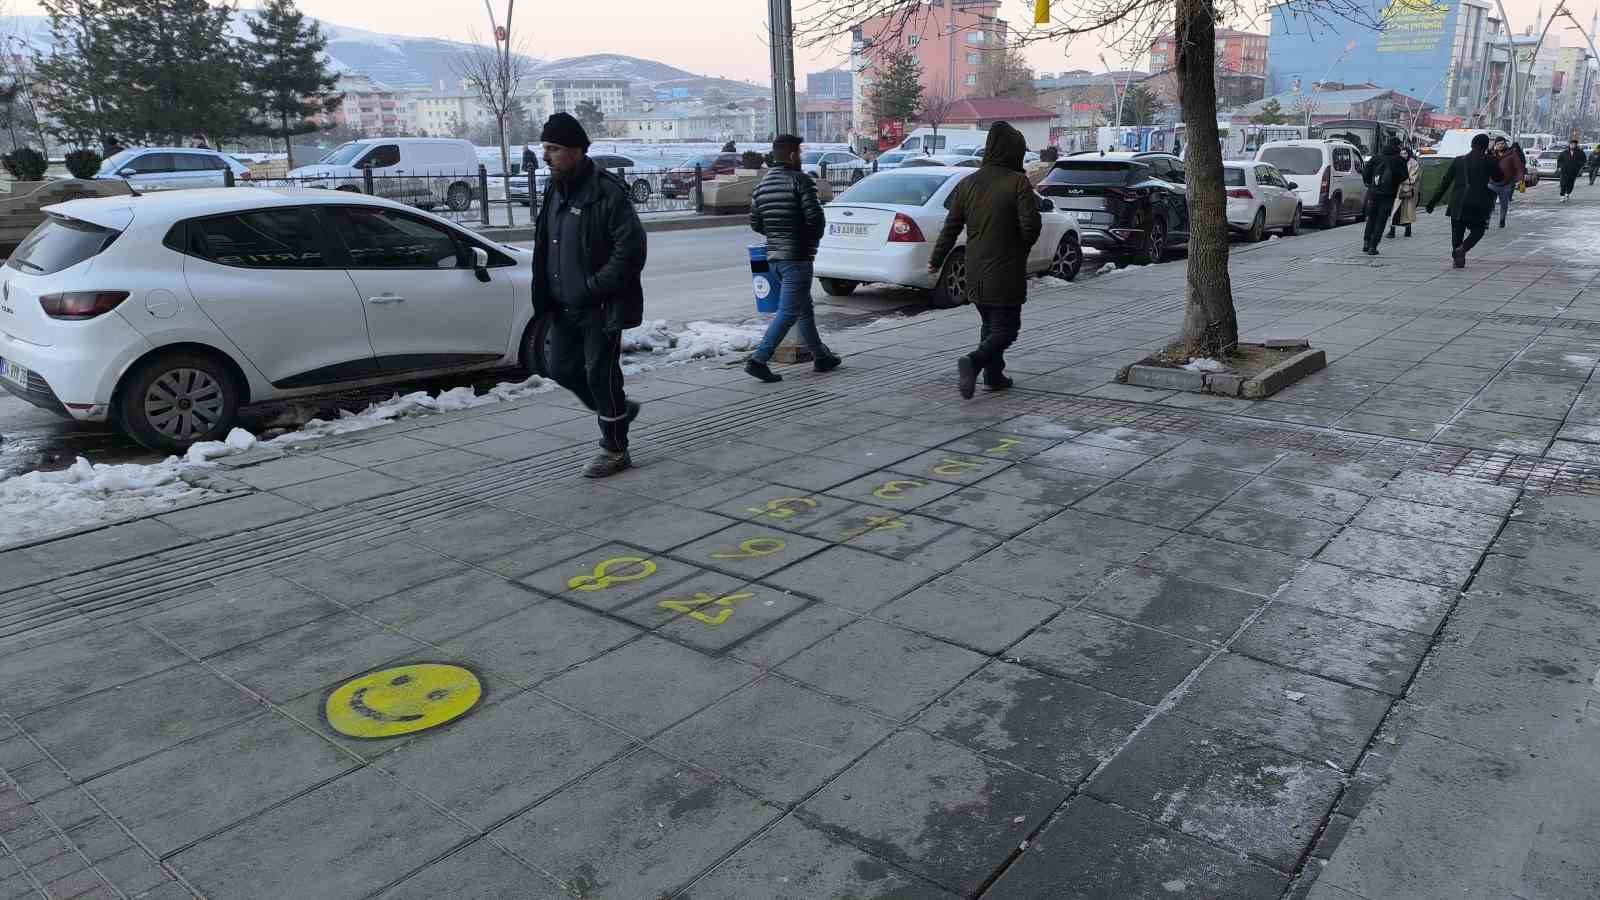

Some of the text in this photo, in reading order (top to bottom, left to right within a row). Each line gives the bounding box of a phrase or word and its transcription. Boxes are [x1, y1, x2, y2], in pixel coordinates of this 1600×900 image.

[932, 457, 985, 476] 2
[872, 480, 928, 500] 3
[747, 496, 817, 518] 5
[840, 515, 906, 536] 4
[568, 556, 656, 591] 8
[657, 592, 754, 626] 7
